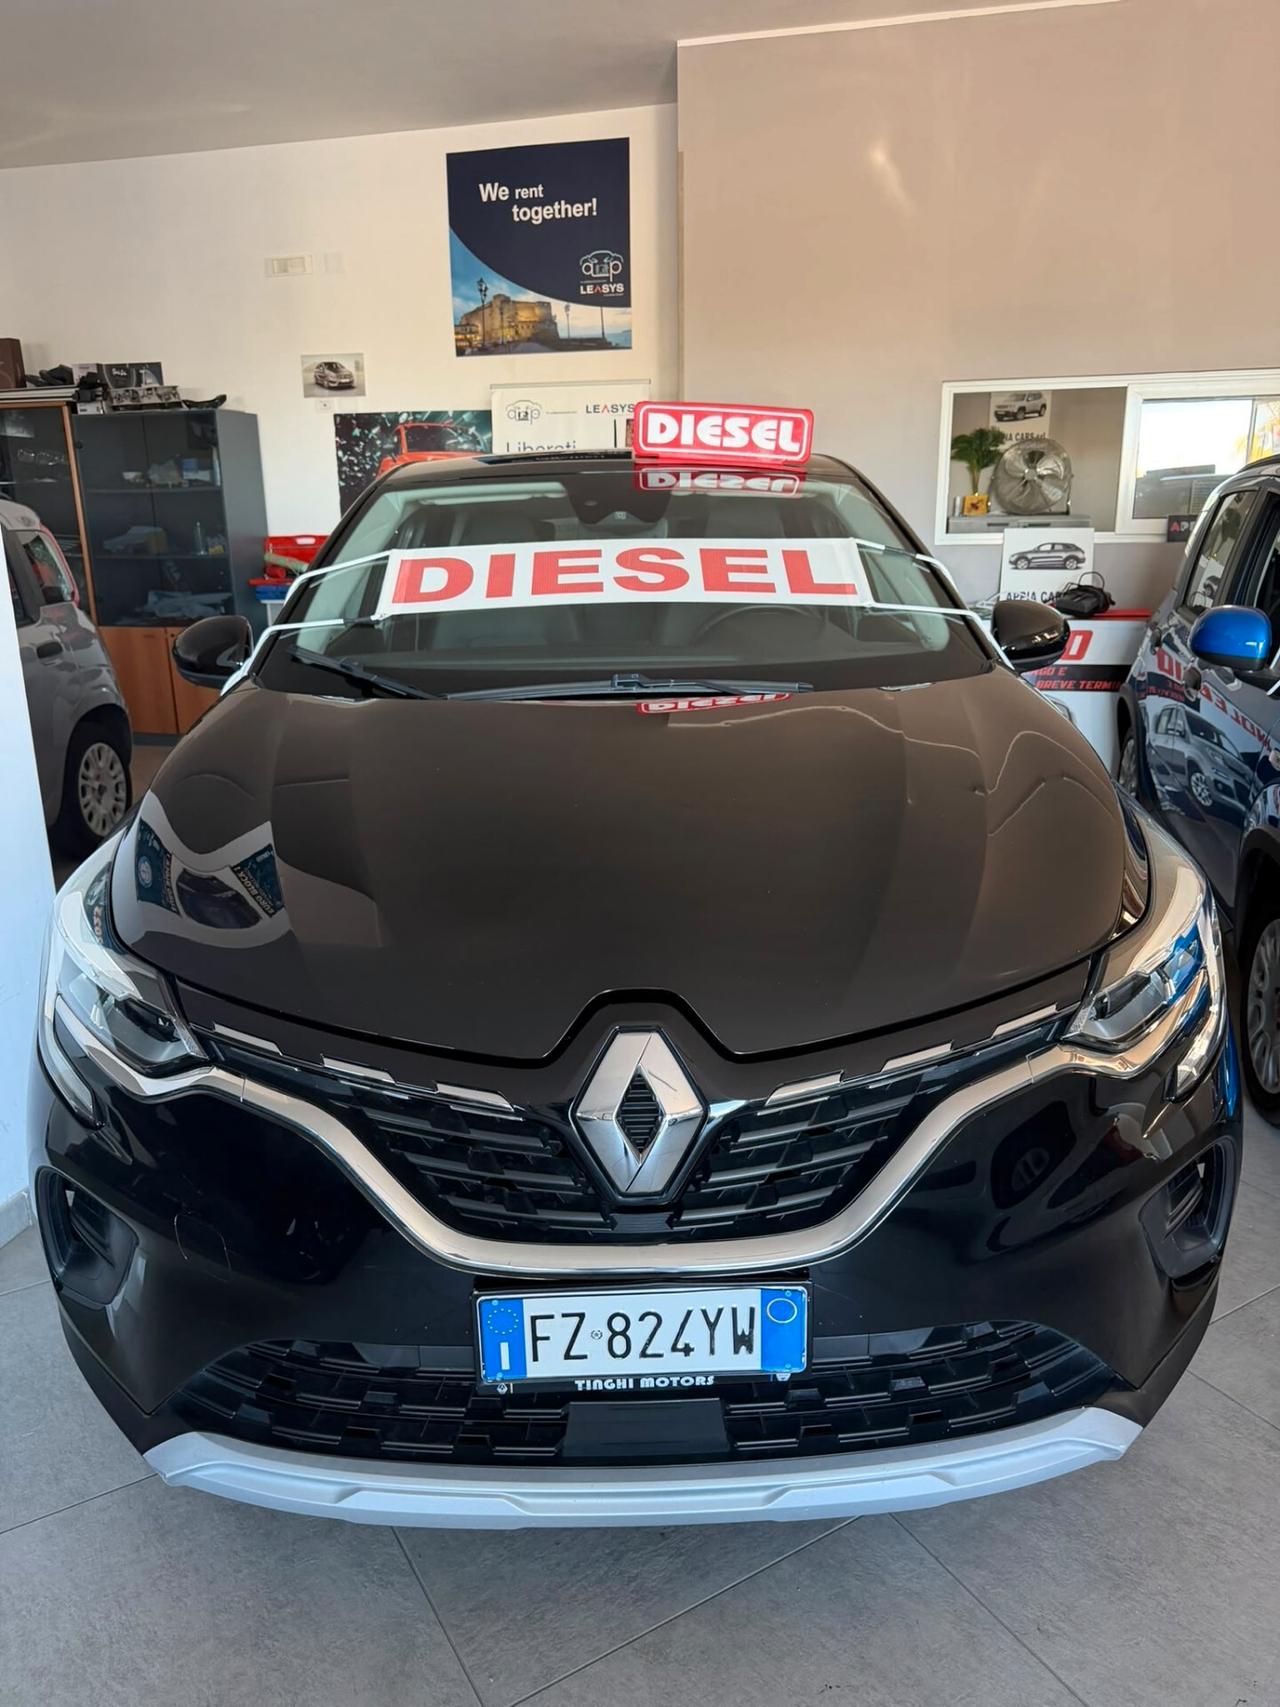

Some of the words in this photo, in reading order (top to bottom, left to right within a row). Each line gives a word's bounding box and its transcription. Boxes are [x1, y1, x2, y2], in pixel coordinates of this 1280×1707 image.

[479, 182, 510, 202] We
[515, 184, 544, 199] rent
[512, 198, 597, 225] together!
[580, 283, 625, 295] LEASYS
[586, 403, 635, 414] LEASYS
[647, 412, 801, 453] DIESEL
[392, 547, 858, 604] DIESEL
[574, 1378, 634, 1391] TINGHI
[640, 1376, 715, 1388] MOTORS
